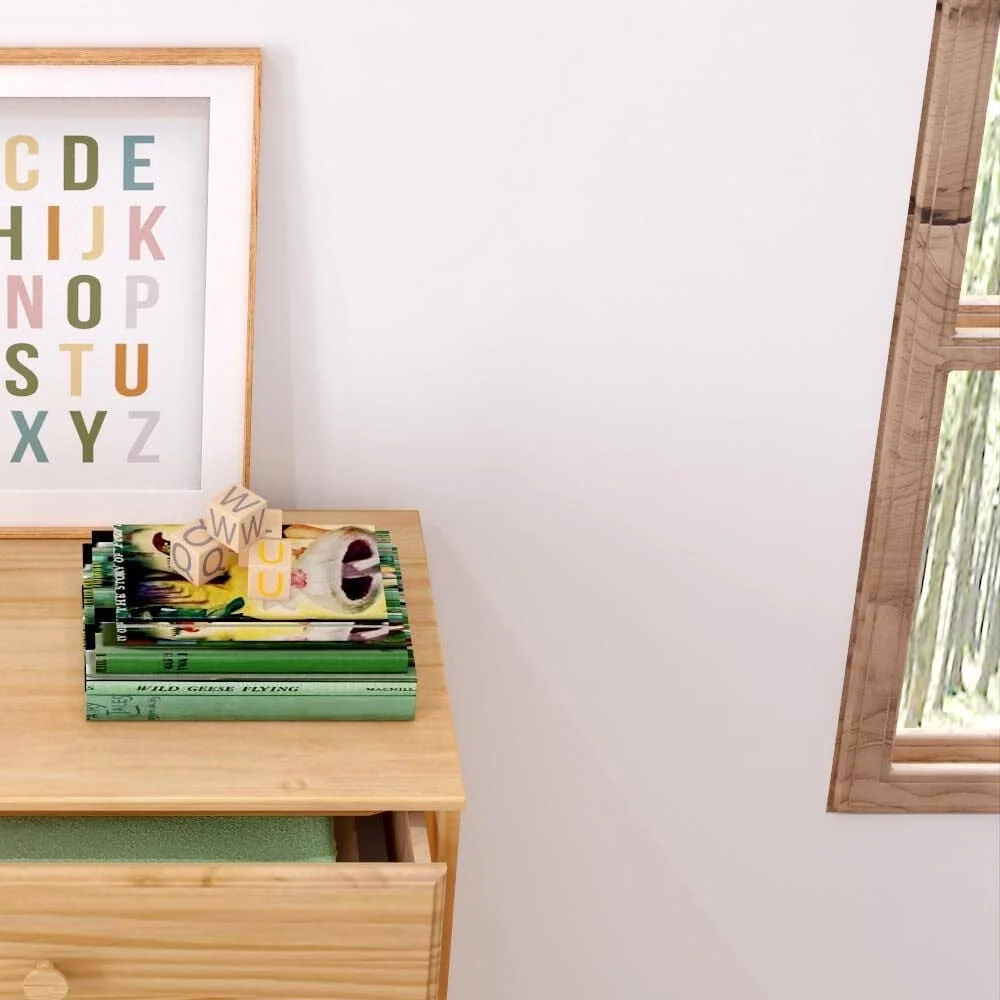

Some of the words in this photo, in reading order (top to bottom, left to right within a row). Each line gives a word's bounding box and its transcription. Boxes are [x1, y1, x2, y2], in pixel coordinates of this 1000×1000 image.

[4, 134, 40, 191] C
[63, 134, 99, 191] D
[122, 134, 155, 191] E
[46, 205, 61, 261] I
[81, 205, 105, 261] J
[128, 205, 167, 261] K
[6, 274, 43, 329] N
[66, 274, 102, 330] O
[125, 274, 160, 329] P
[4, 342, 40, 398] S
[58, 343, 94, 397] T
[114, 343, 150, 398] U
[9, 410, 50, 463] X
[69, 410, 108, 463] Y
[126, 410, 161, 463] Z
[210, 507, 237, 546] W
[241, 507, 266, 545] W
[258, 541, 284, 565] U
[257, 571, 284, 598] U
